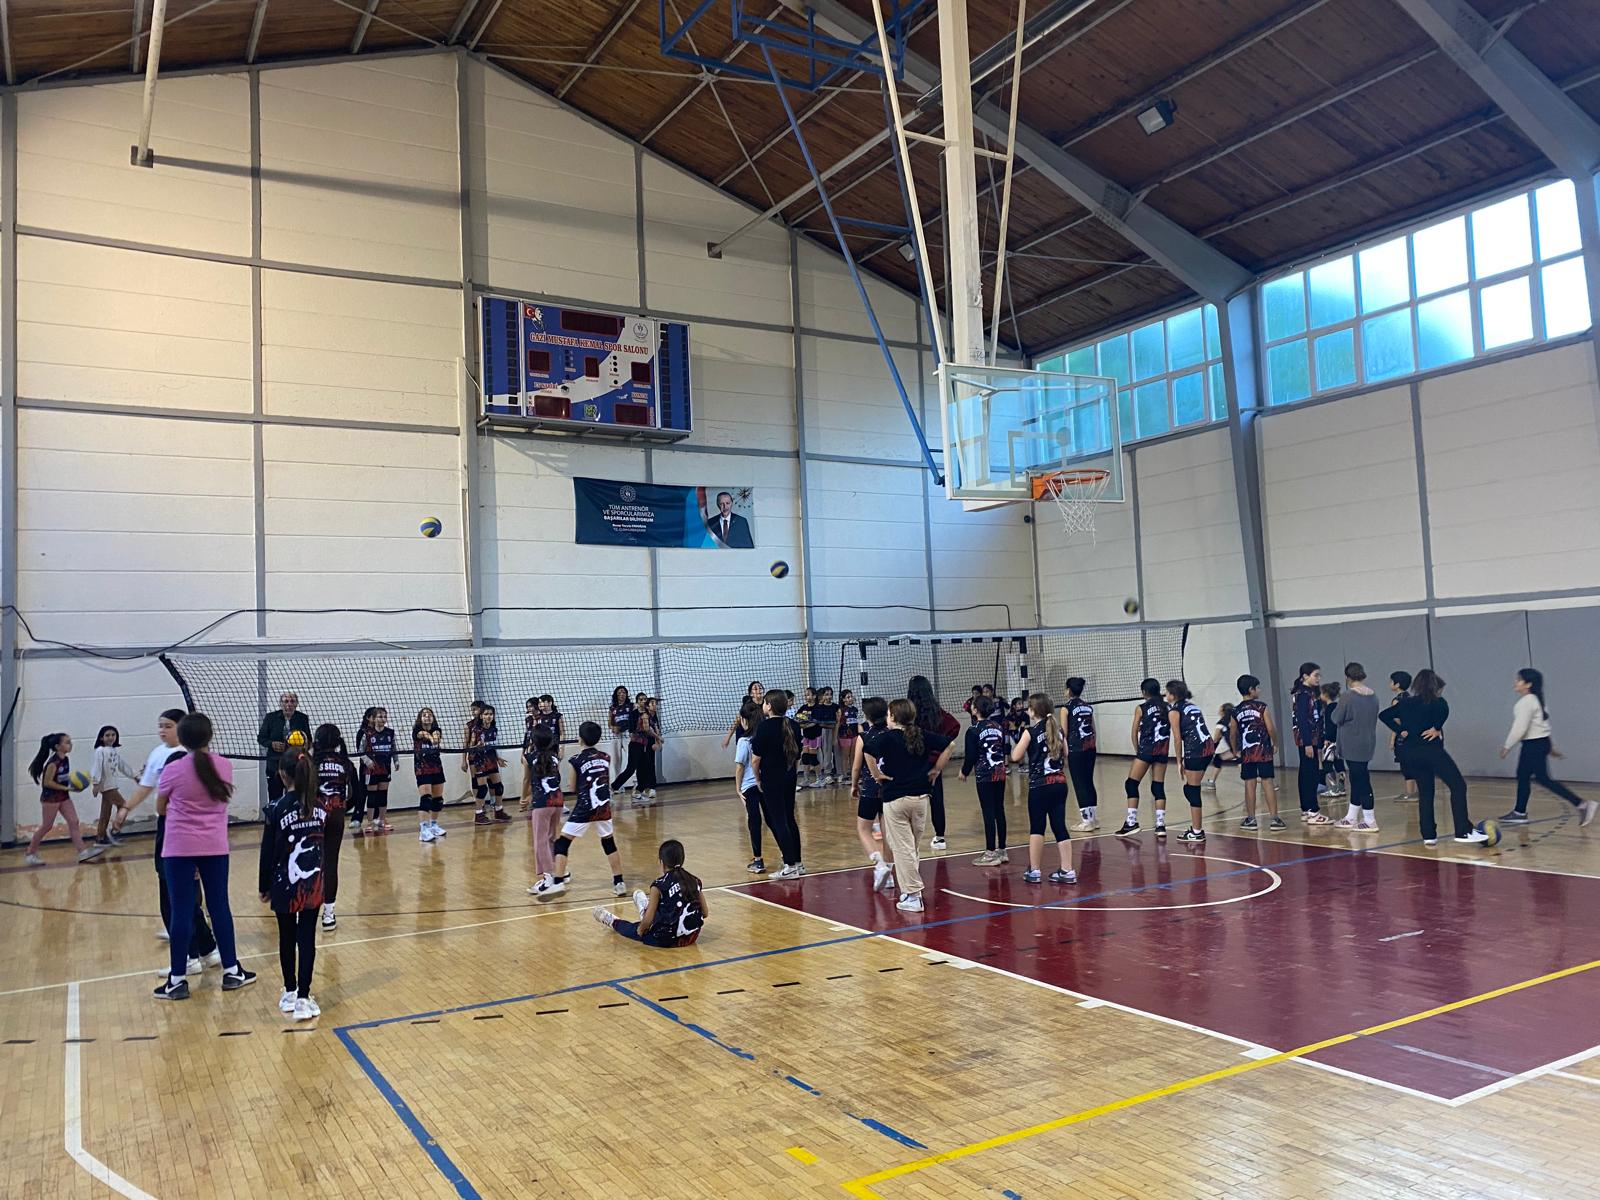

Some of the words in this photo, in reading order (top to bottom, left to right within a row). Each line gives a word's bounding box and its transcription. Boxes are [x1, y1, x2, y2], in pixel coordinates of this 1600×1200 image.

[530, 331, 546, 343] GAZİ
[547, 334, 579, 347] MUSTAFA
[579, 338, 603, 350] KEMAL
[604, 341, 622, 352] SPOR
[623, 345, 649, 355] SALONU
[280, 810, 298, 830] EFES
[290, 820, 321, 831] VOLEYBOL
